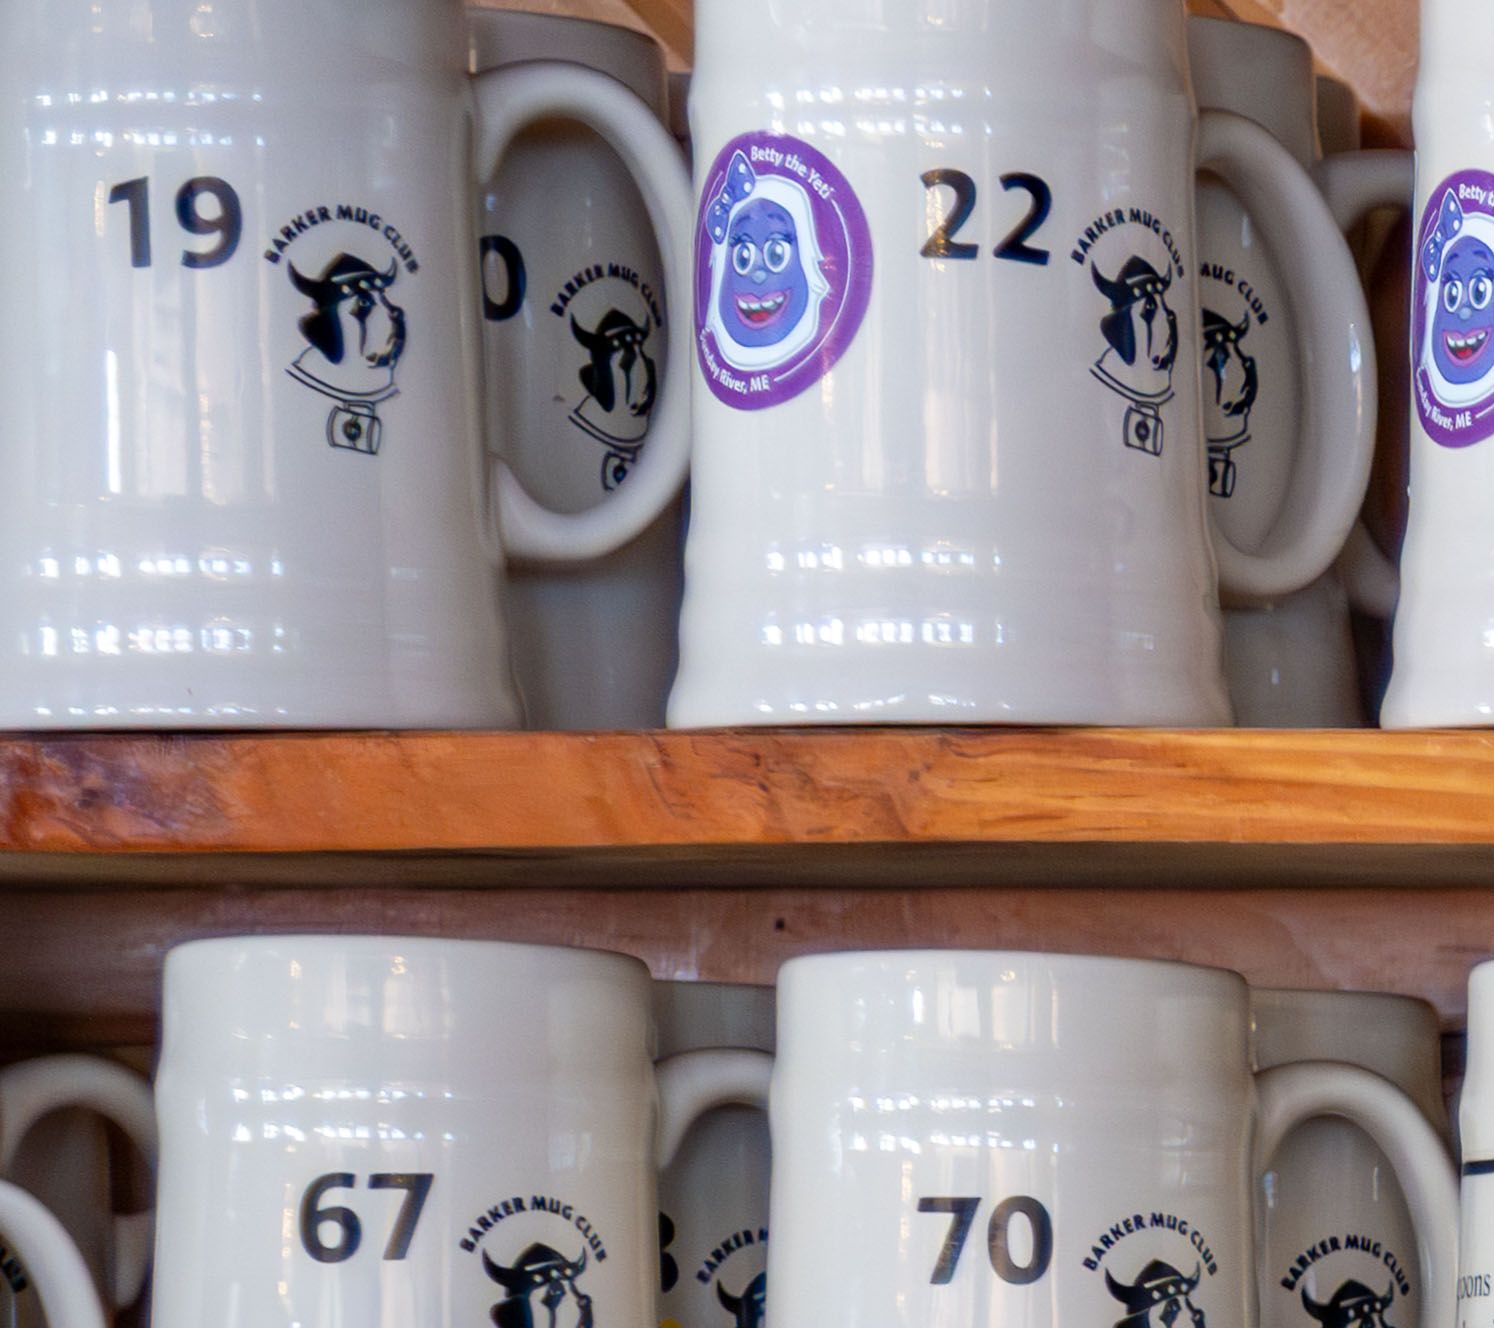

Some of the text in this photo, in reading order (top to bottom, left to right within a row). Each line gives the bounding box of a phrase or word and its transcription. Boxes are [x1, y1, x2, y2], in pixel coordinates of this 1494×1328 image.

[750, 145, 834, 200] Betty the Yeti
[1458, 183, 1487, 204] Betty
[108, 176, 244, 270] 19
[264, 204, 421, 276] BARKER MUG CLUB
[919, 167, 1052, 266] 22
[1070, 207, 1185, 280] BARKER MUG CLUB
[718, 371, 770, 395] River, ME
[299, 1173, 434, 1263] 67
[458, 1195, 606, 1264] BARKER MUG CLUB
[917, 1194, 1053, 1286] 70
[1082, 1212, 1218, 1278] BARKER MUG CLUB
